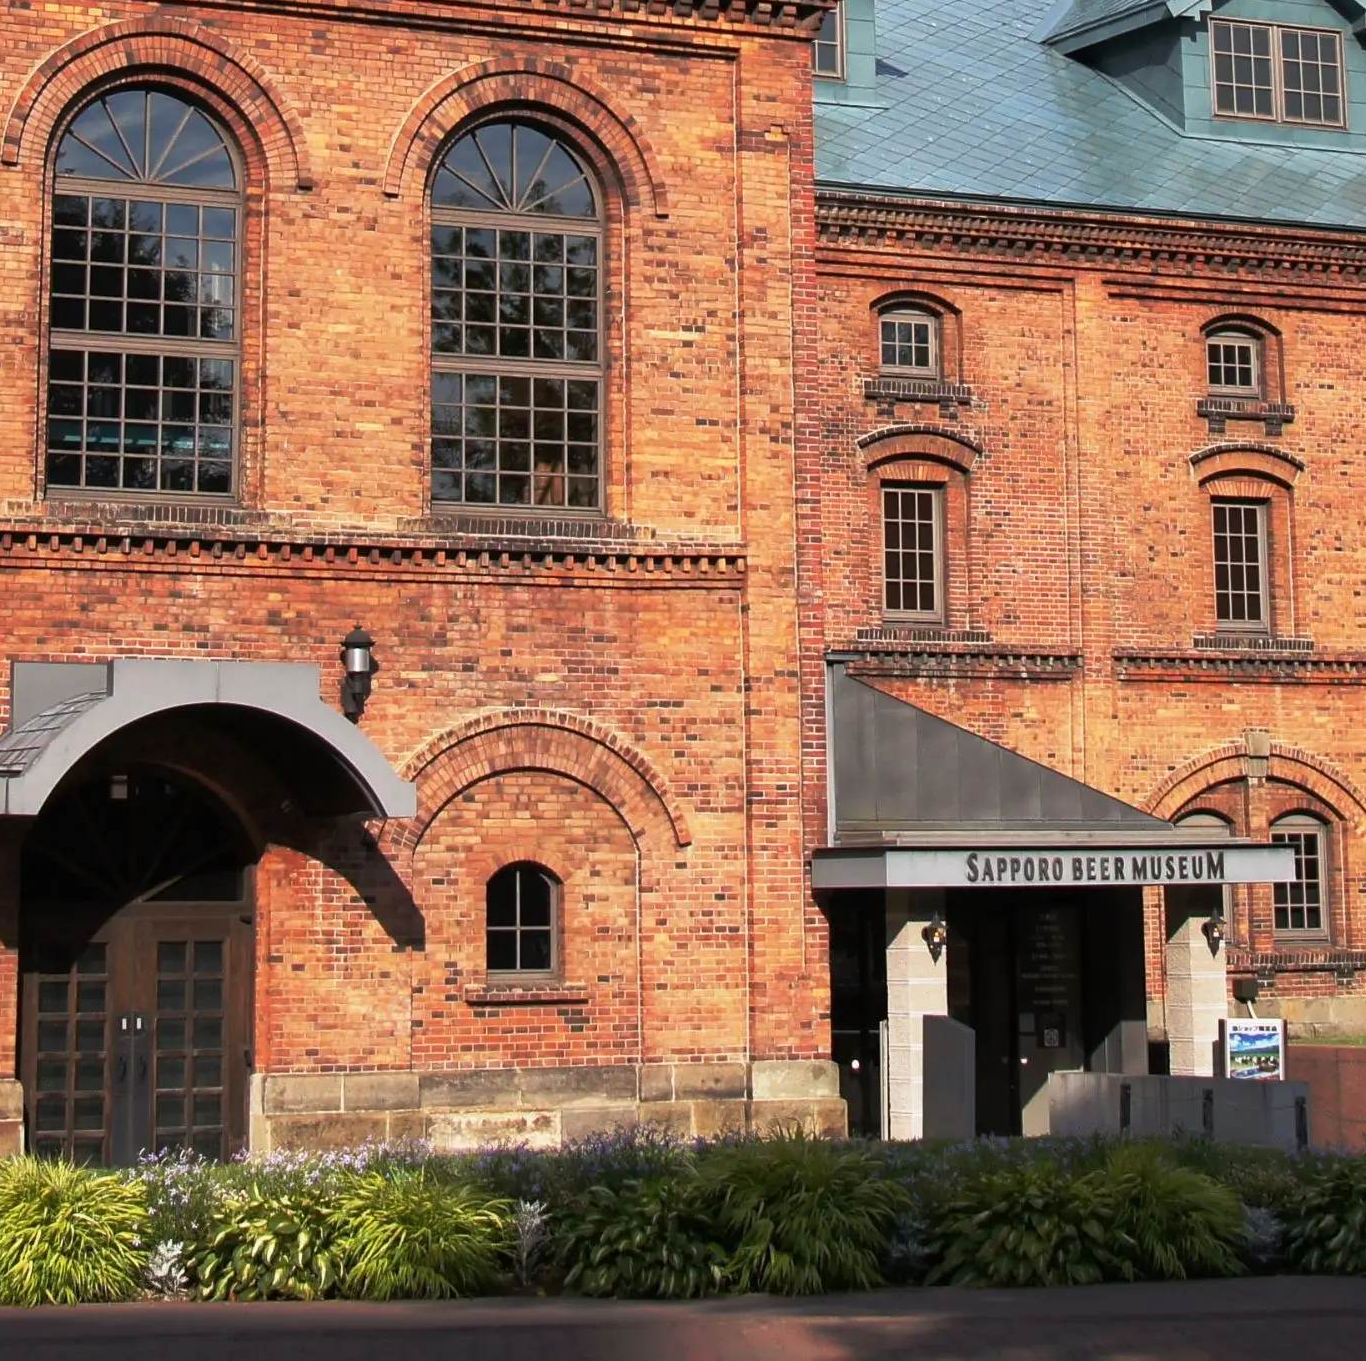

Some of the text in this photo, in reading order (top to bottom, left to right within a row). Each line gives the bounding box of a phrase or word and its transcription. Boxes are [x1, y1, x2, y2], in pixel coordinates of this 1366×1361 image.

[966, 851, 1225, 883] SAPPORO BEER MUSEUM
